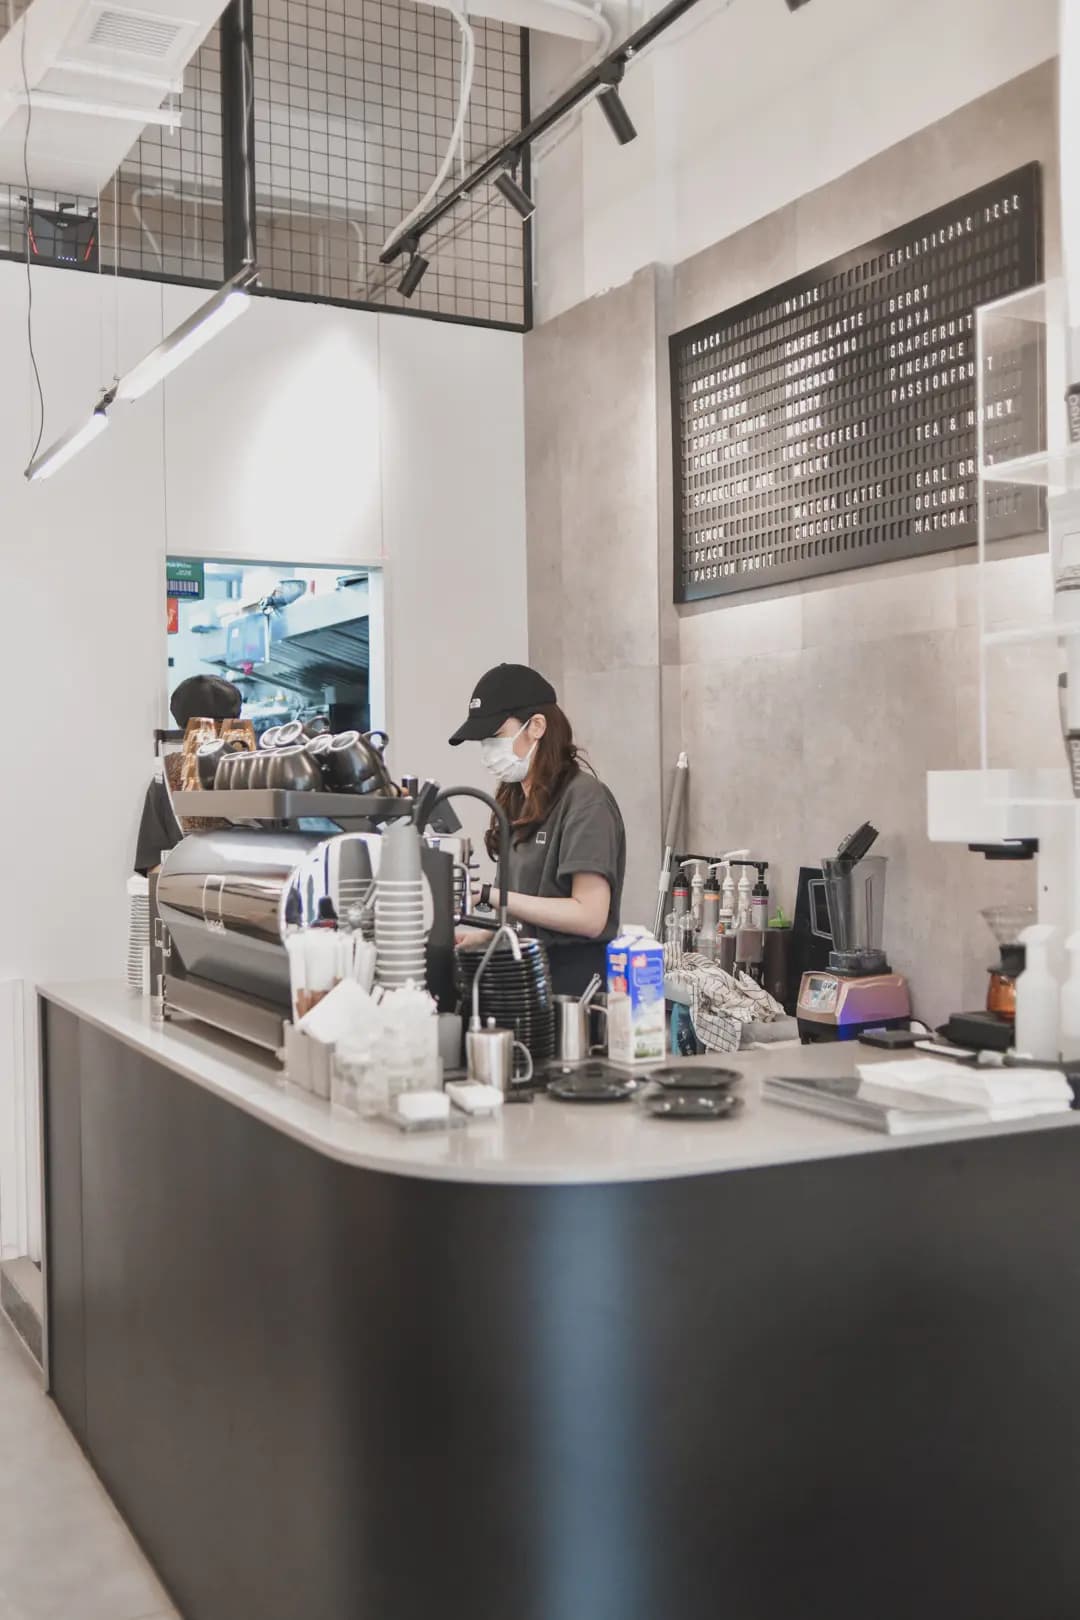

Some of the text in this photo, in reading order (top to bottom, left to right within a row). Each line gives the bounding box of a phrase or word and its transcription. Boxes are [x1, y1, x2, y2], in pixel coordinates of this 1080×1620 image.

[889, 284, 929, 313] BERRY
[786, 311, 864, 357] CAFFE LATTE
[890, 307, 930, 336] GUAVA
[692, 332, 720, 356] BLACK
[890, 314, 974, 359] GRAPEFRUIT
[784, 337, 858, 380] CAPPUCCINO
[890, 341, 965, 382] PINEAPPLE
[692, 361, 747, 394] AMERICANO
[785, 367, 835, 400] PICCOLO
[891, 355, 994, 404] PASSIONFRUT
[693, 383, 741, 413] ESPRESSO
[785, 394, 821, 421] DIRTY
[693, 400, 747, 431] COLD BREW
[785, 415, 822, 441] MOCHA
[916, 421, 940, 441] TEA
[949, 417, 956, 431] &
[693, 414, 766, 450] COFFEE TONIC
[694, 450, 719, 470] POUR
[794, 455, 829, 478] MILKY
[916, 454, 994, 488] EARL GRY
[694, 472, 774, 508] SPARKLING ADE
[794, 484, 881, 519] MATCHA LATTE
[915, 486, 965, 511] OOLONG
[695, 526, 724, 545] LEMON
[795, 511, 858, 540] CHOCOLATE
[915, 509, 966, 534] MATCHA
[694, 553, 772, 582] PASSION FRUIT
[695, 546, 723, 563] PEACH
